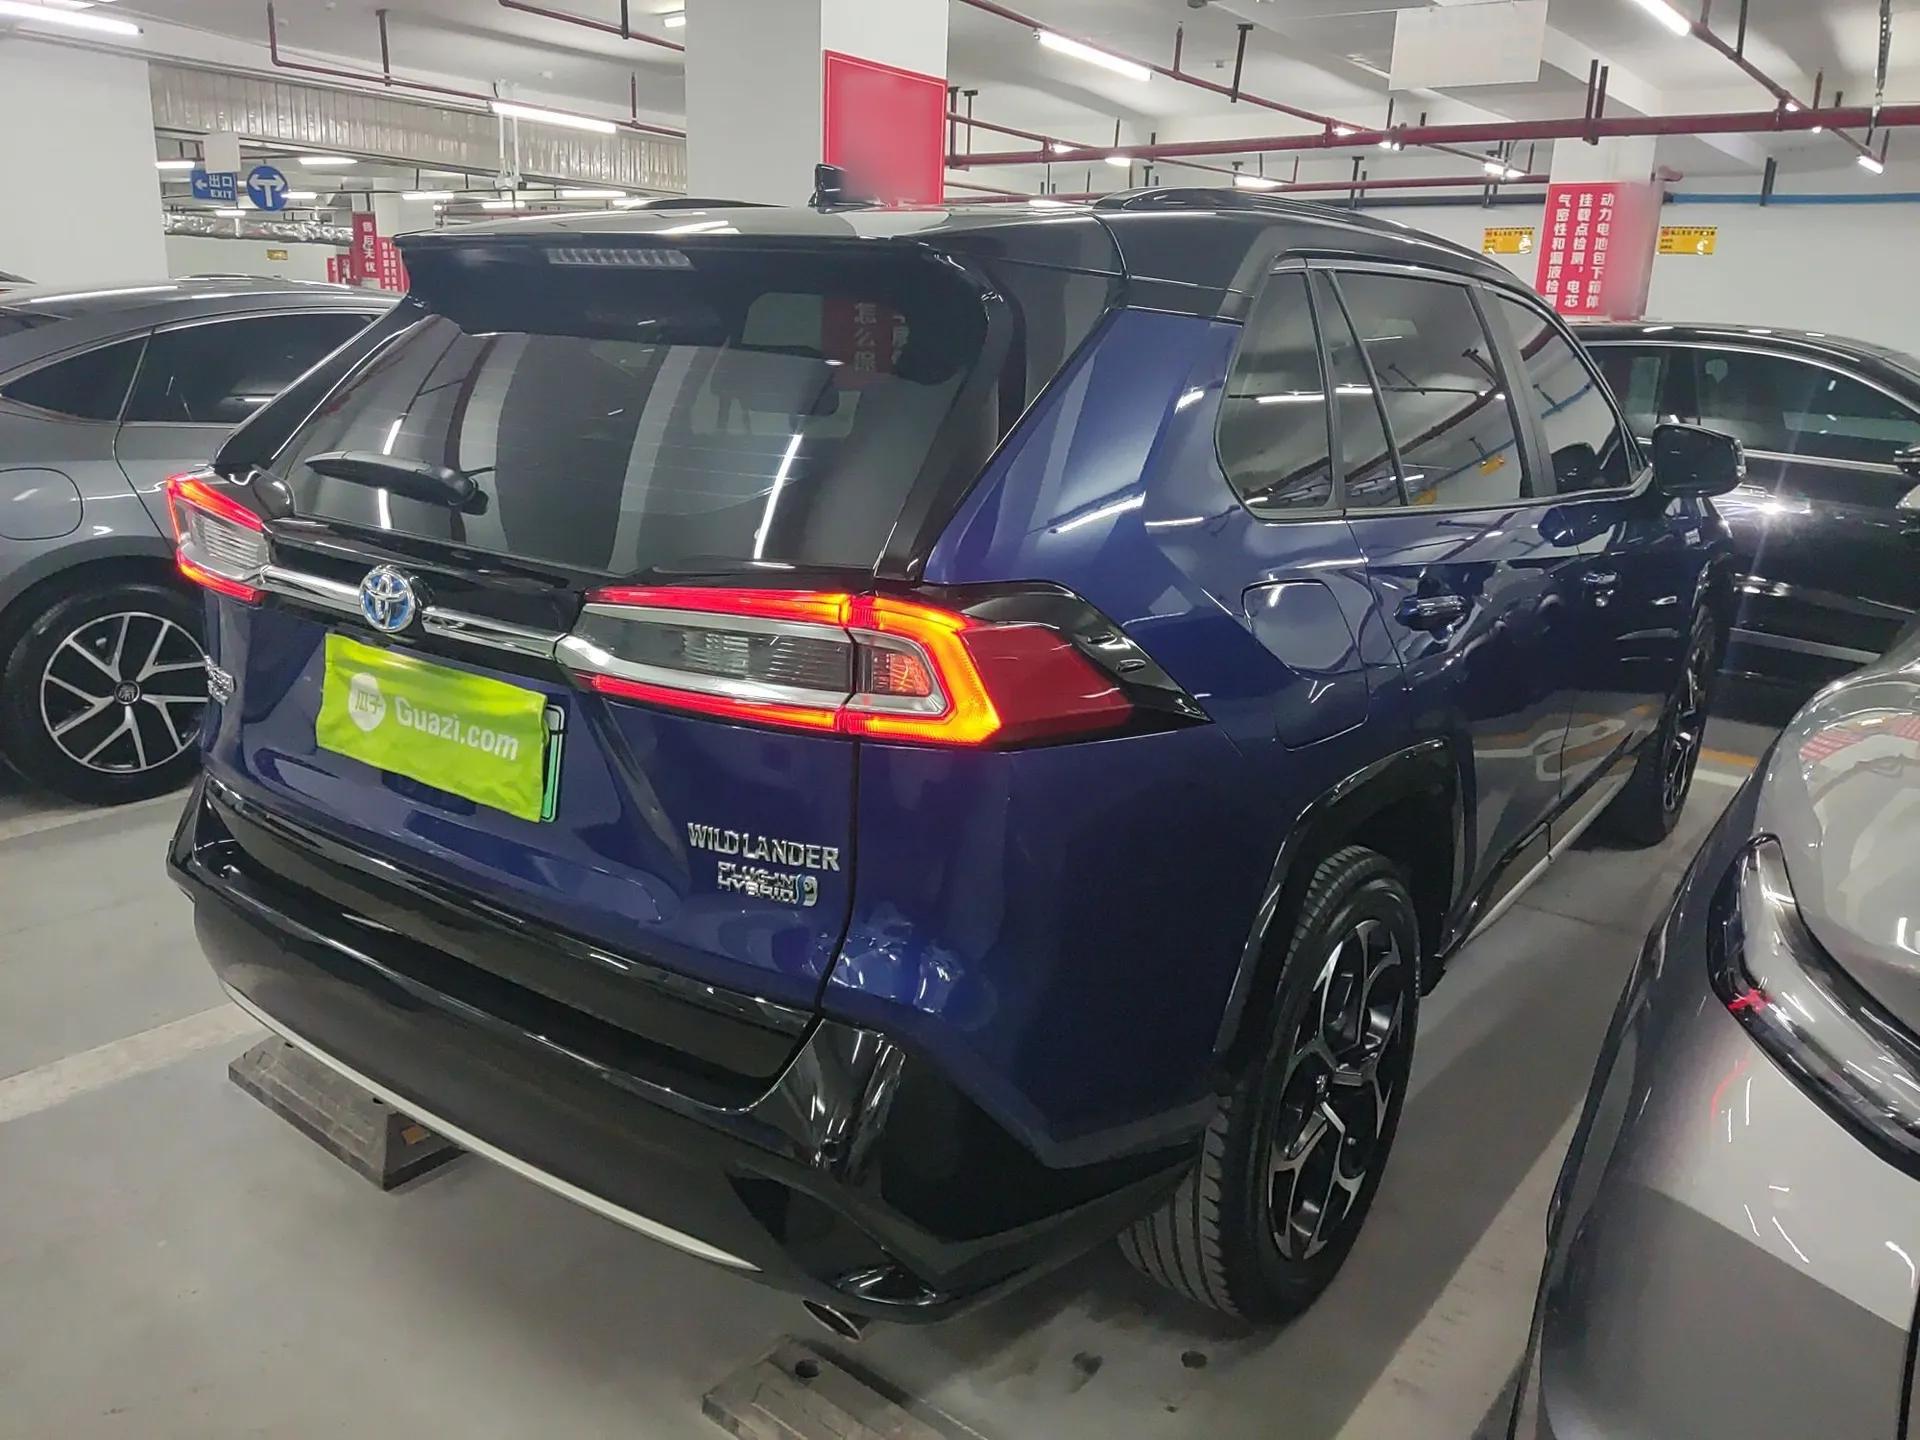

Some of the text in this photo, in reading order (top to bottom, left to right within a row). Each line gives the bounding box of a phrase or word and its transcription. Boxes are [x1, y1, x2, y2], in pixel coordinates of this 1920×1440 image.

[208, 174, 233, 188] 出口
[210, 189, 233, 199] EXIT
[395, 696, 520, 761] Guazi.com
[717, 877, 798, 905] HYBRID
